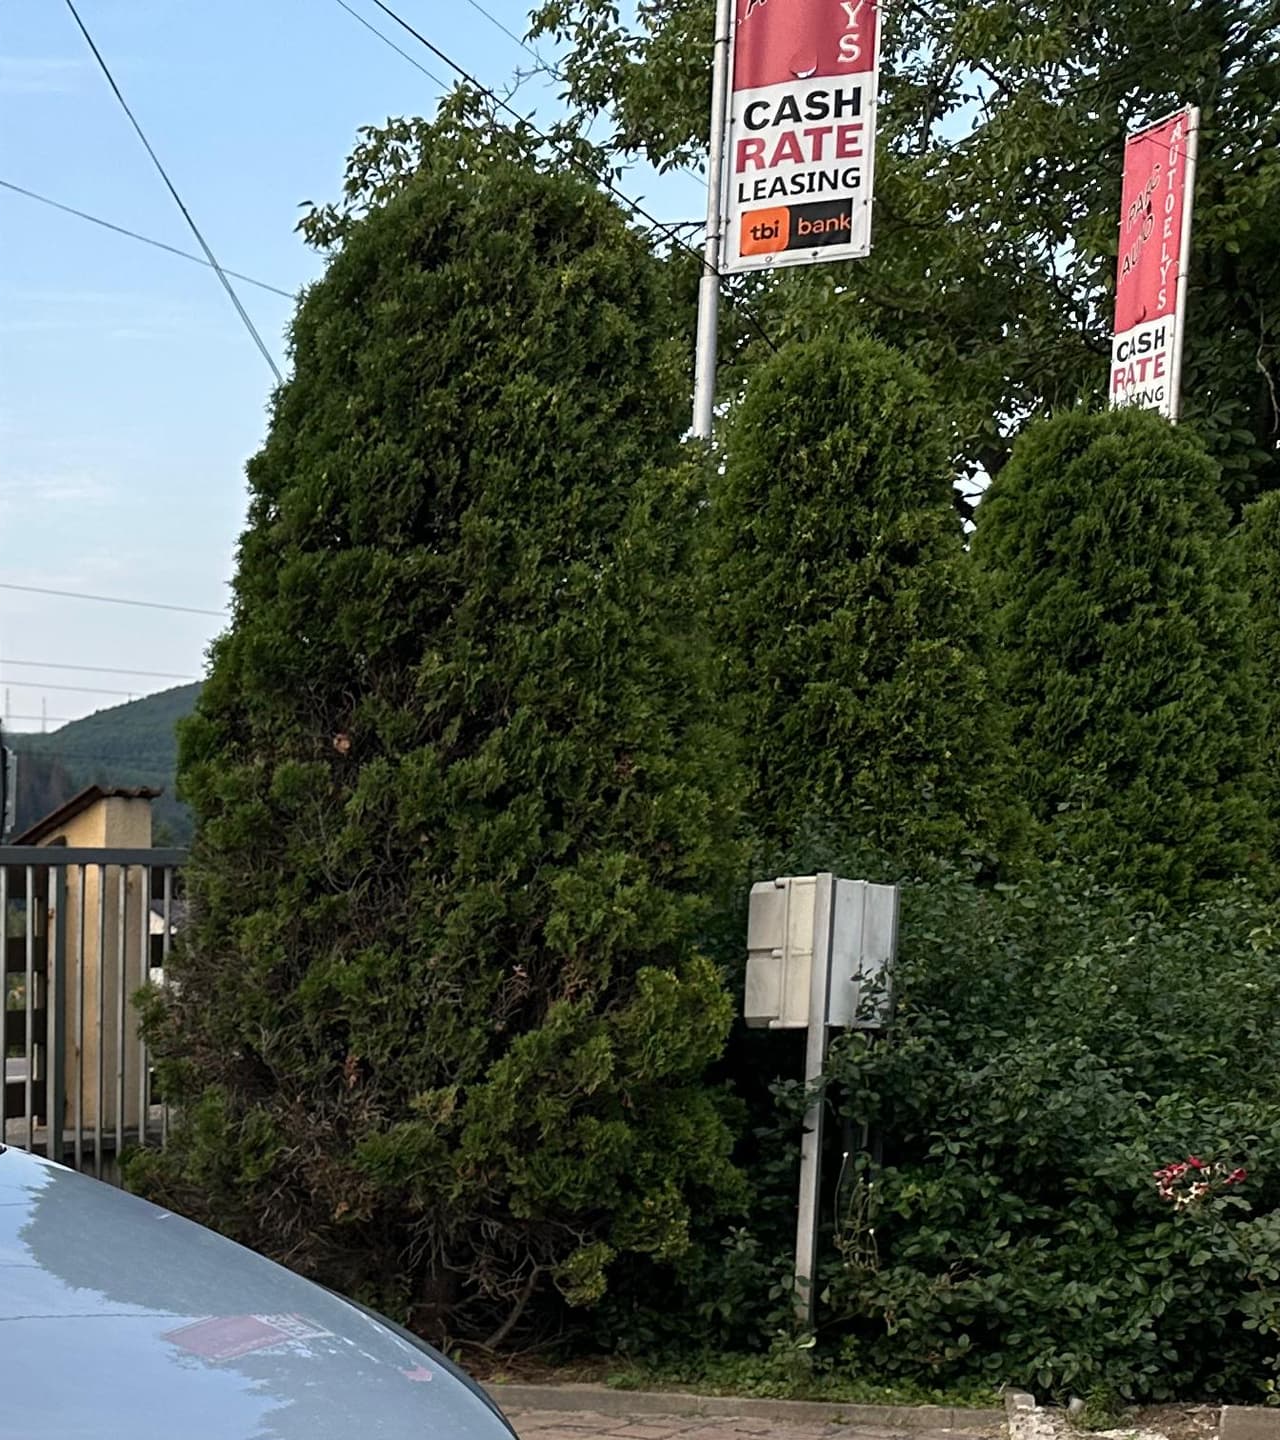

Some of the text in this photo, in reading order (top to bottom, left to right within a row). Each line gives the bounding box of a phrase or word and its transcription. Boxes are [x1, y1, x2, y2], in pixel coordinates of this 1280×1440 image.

[743, 87, 862, 131] CASH
[735, 123, 864, 174] RATE
[738, 167, 861, 203] LEASING
[750, 212, 851, 241] tbi bank
[1157, 121, 1182, 310] AUTOELYS
[1116, 326, 1165, 362] CASH
[1113, 351, 1166, 394] RATE
